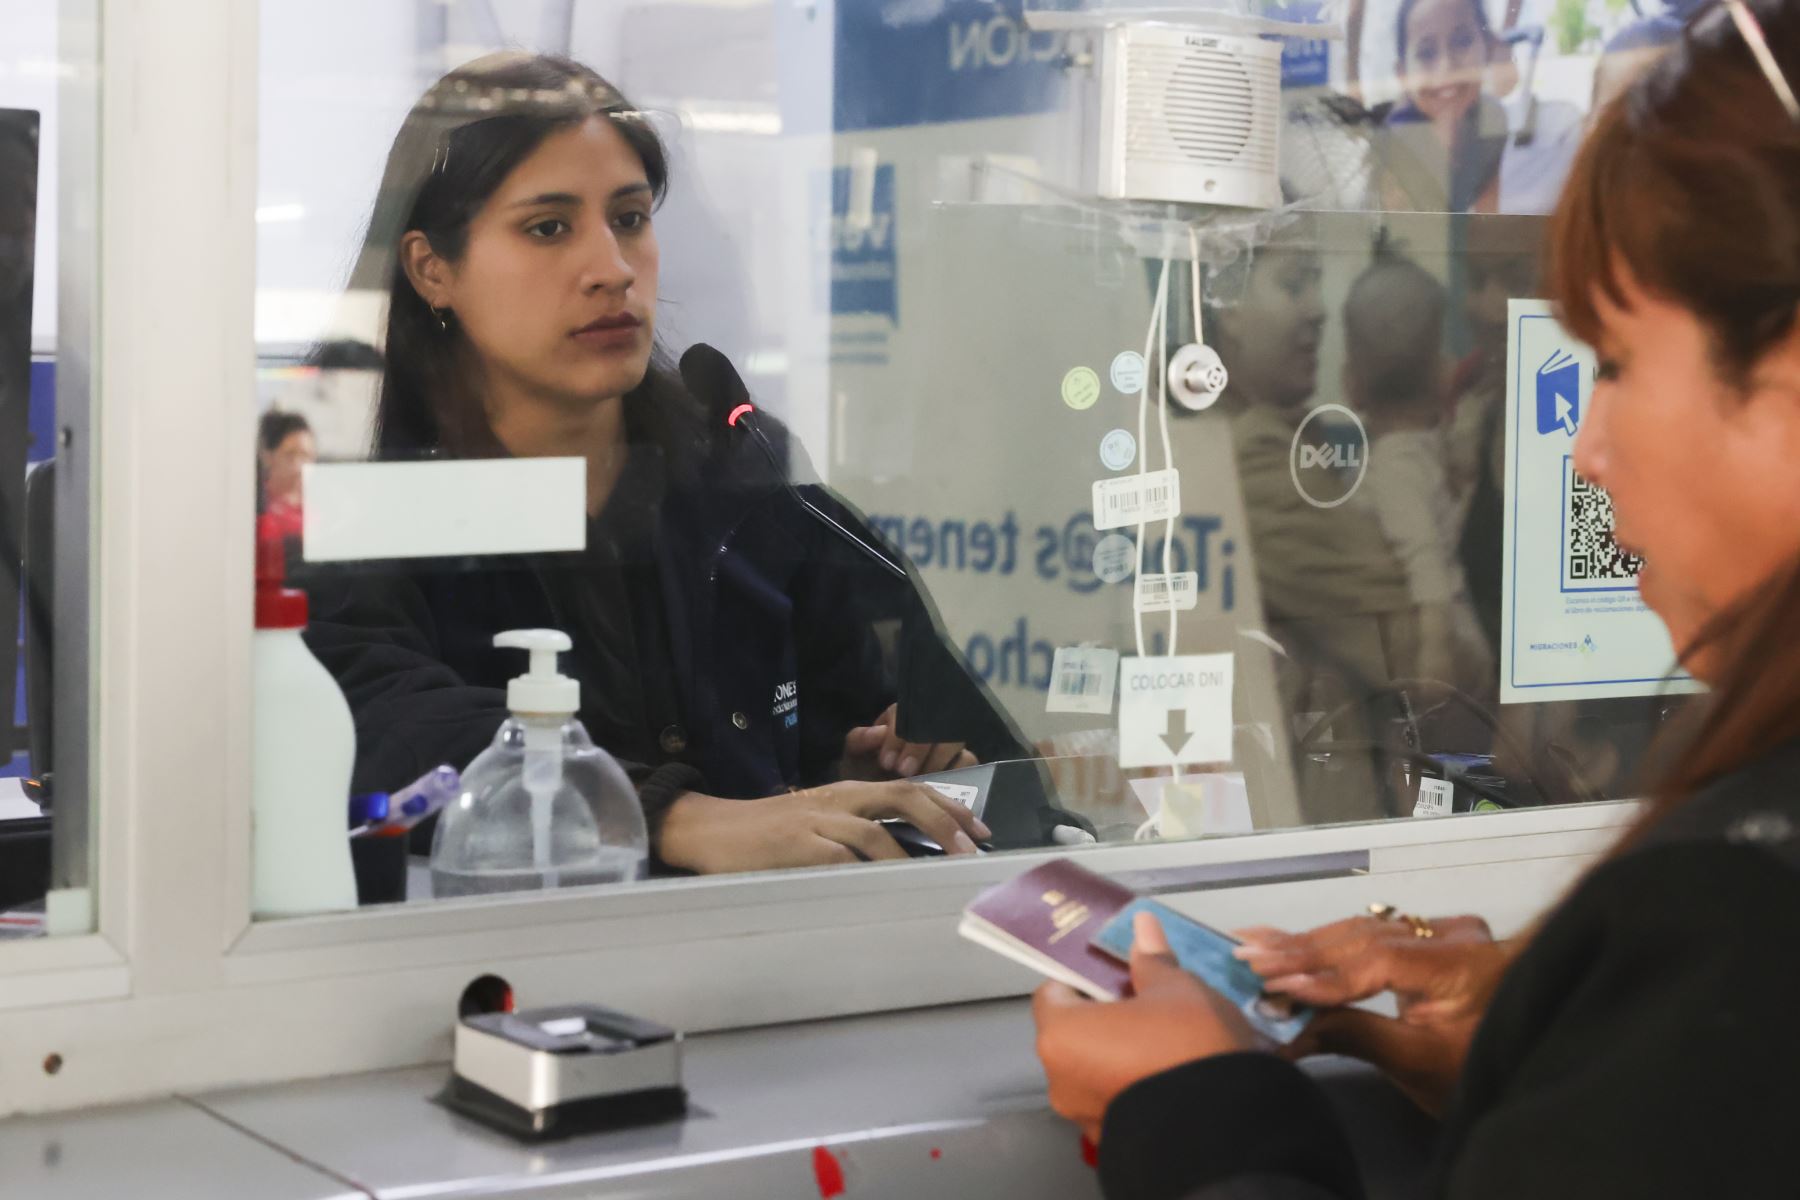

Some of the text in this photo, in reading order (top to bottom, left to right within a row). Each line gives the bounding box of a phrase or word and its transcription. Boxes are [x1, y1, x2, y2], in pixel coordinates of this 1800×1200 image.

[1300, 442, 1359, 469] DELL
[774, 681, 797, 702] ONES
[1130, 671, 1224, 692] COLOCAR DNI
